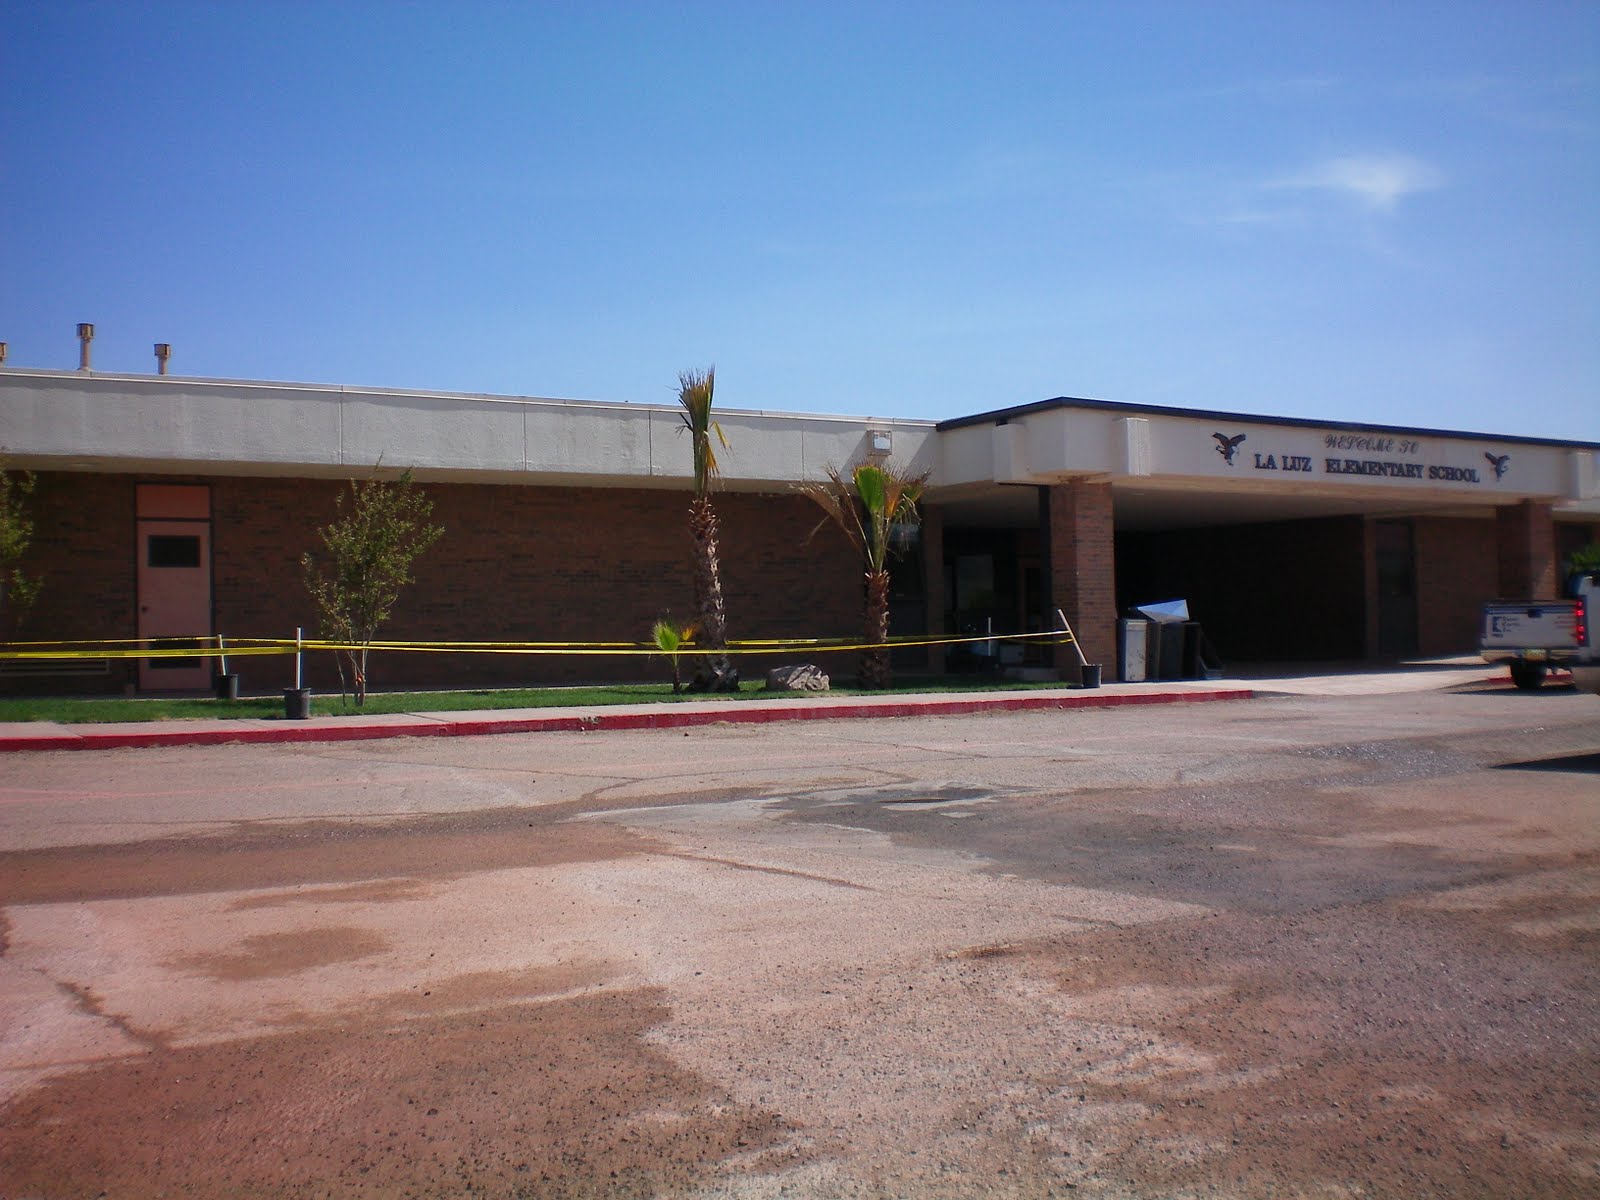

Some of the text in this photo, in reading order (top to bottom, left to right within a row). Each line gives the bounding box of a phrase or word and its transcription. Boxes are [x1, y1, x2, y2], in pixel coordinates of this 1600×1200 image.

[1325, 434, 1419, 453] WELCOME TO
[1254, 453, 1480, 482] LA LUZ ELEMENTARY SCHOOL
